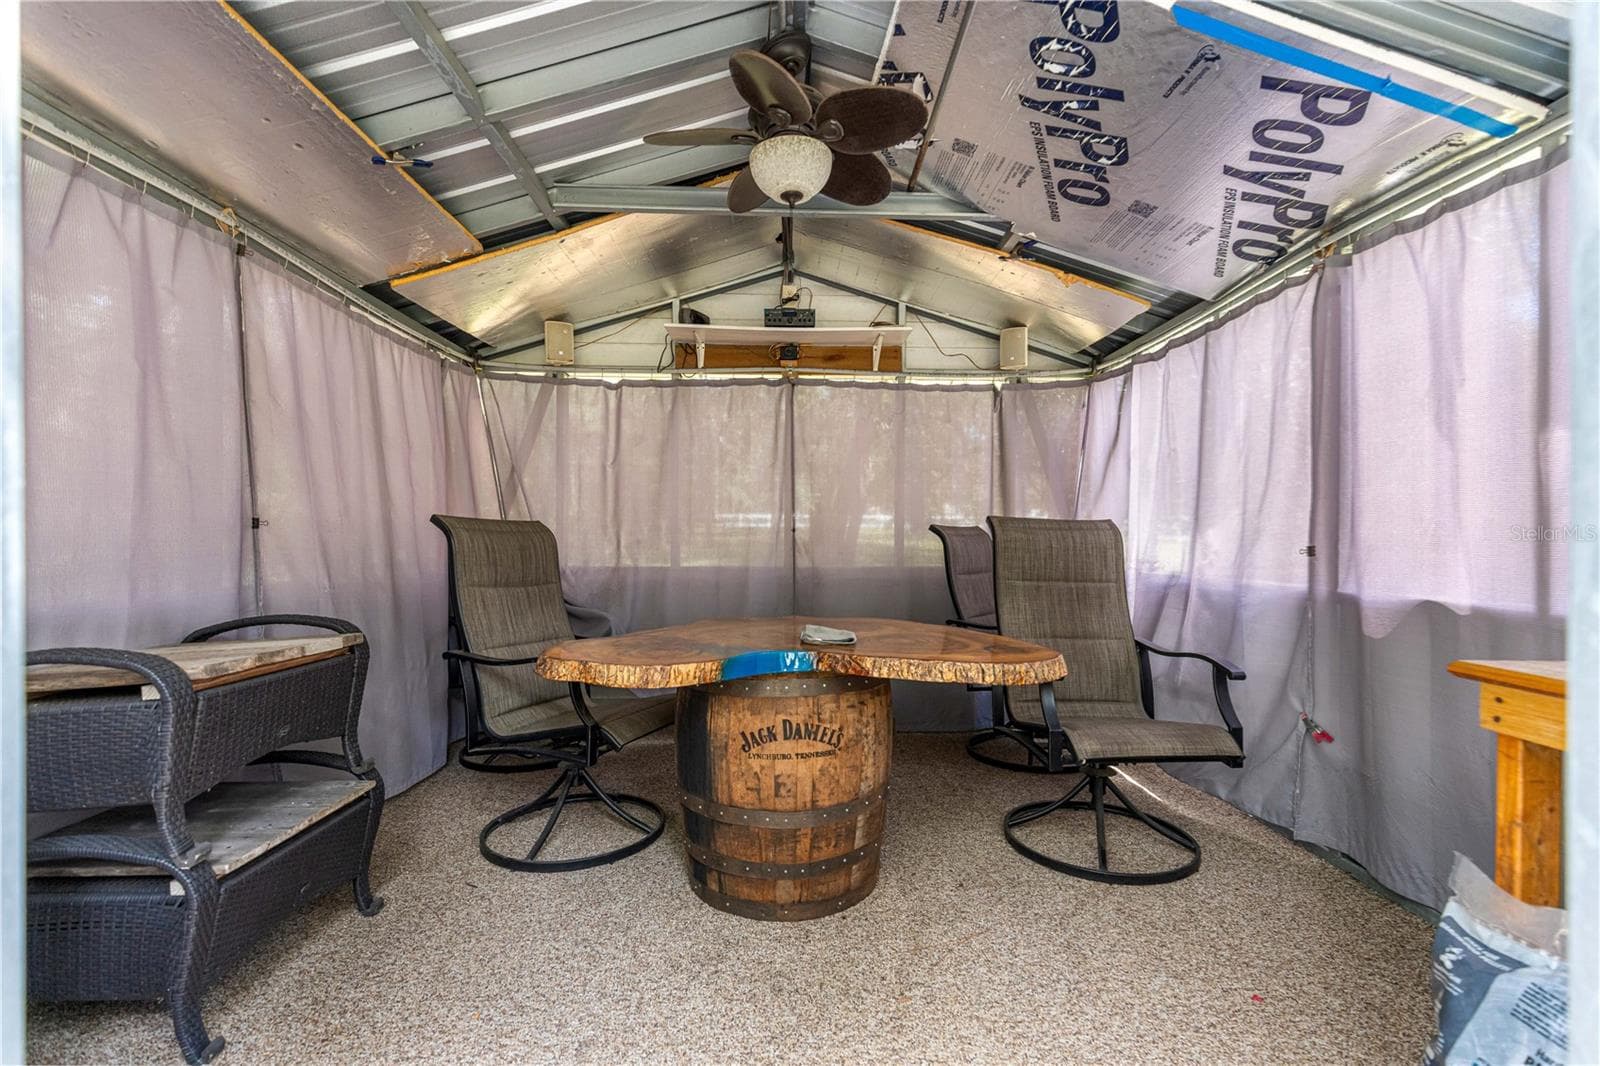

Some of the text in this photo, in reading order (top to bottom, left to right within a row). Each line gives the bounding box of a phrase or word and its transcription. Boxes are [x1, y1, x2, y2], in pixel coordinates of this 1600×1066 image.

[1018, 0, 1130, 206] PolyPro
[1029, 121, 1061, 222] EPS INSULATION FOAM BOARD
[1223, 75, 1372, 266] PolyPro
[1213, 187, 1237, 278] EPS INSULATION FOAM BOARD
[740, 719, 844, 753] JACK DANIEL'S
